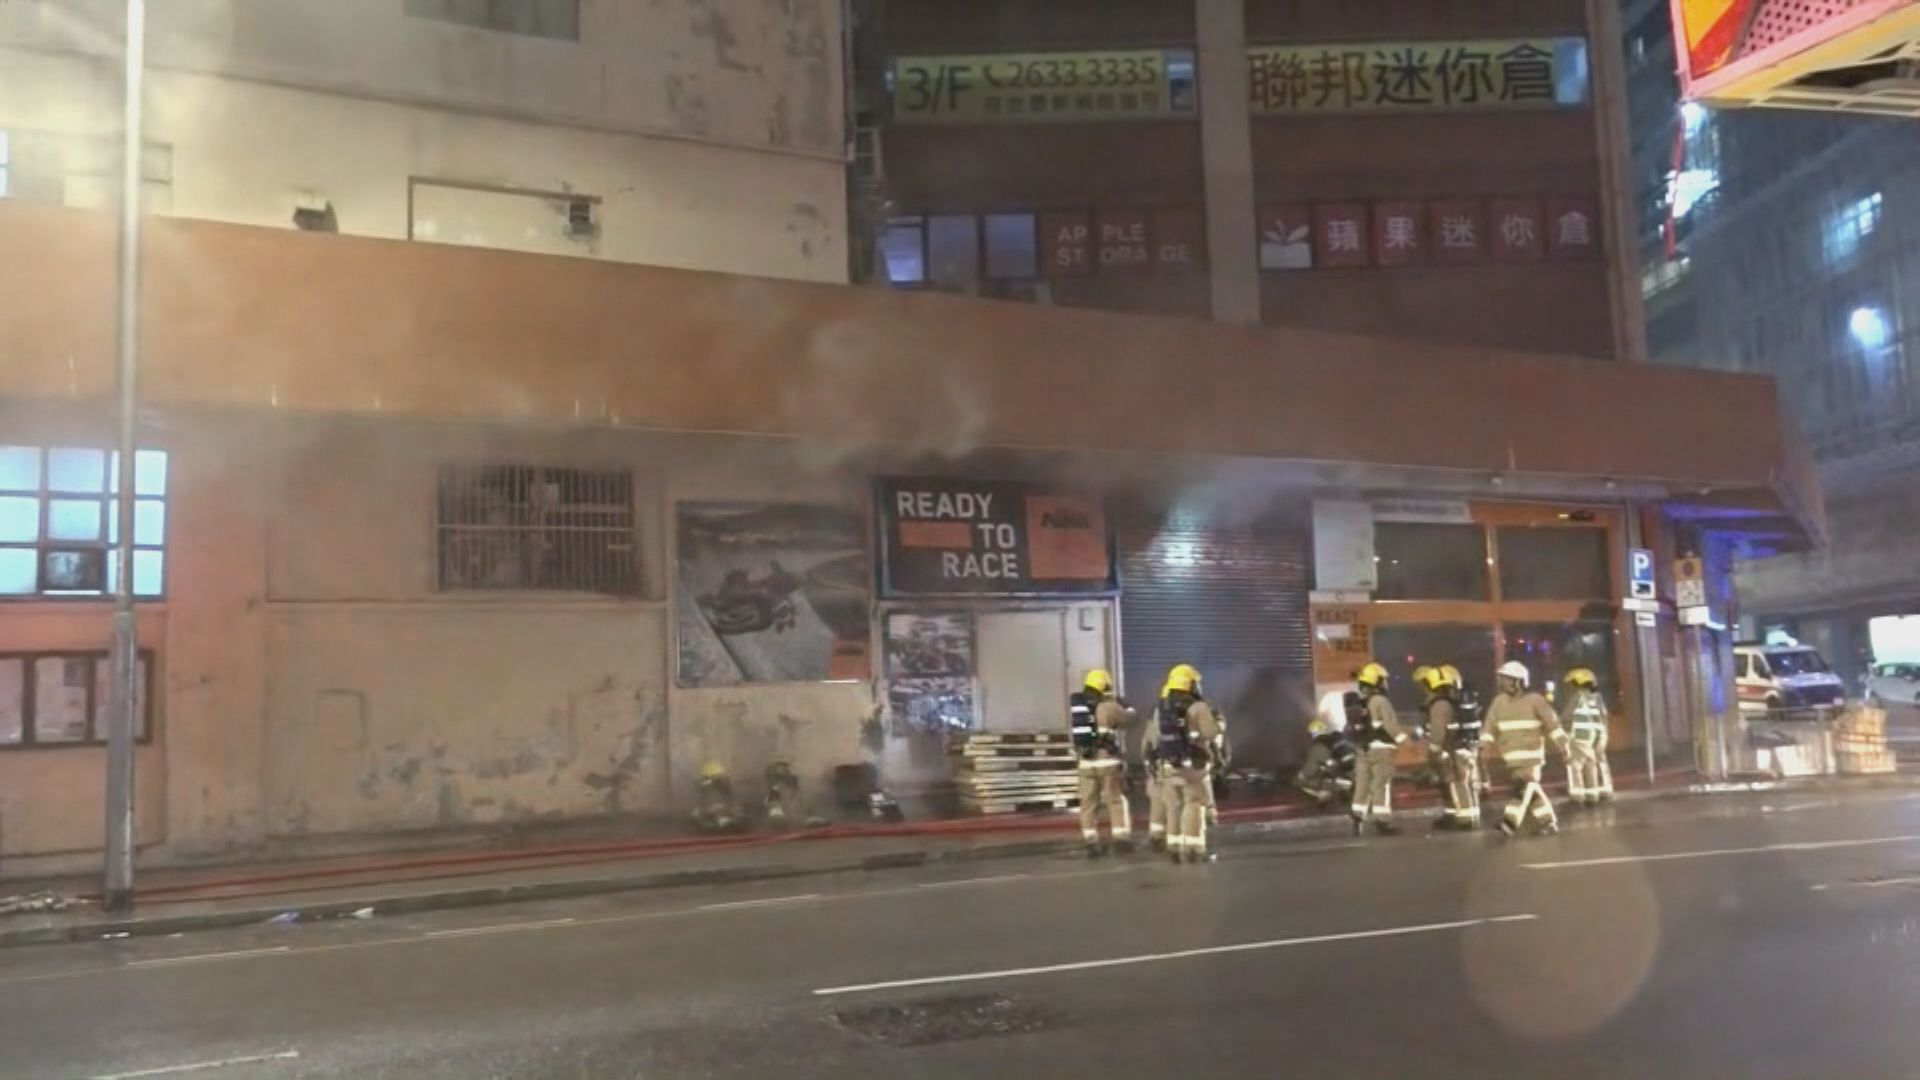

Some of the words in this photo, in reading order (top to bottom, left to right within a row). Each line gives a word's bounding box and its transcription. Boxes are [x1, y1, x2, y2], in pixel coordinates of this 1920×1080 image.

[906, 64, 973, 113] 3/F
[1008, 60, 1078, 88] 2633
[1087, 56, 1157, 87] 3335
[1246, 43, 1554, 108] 聯邦迷你倉
[1327, 211, 1591, 252] 蘋果迷你倉
[896, 491, 993, 519] READY
[978, 523, 1016, 549] TO
[942, 552, 1019, 578] RACE
[1633, 552, 1649, 578] P
